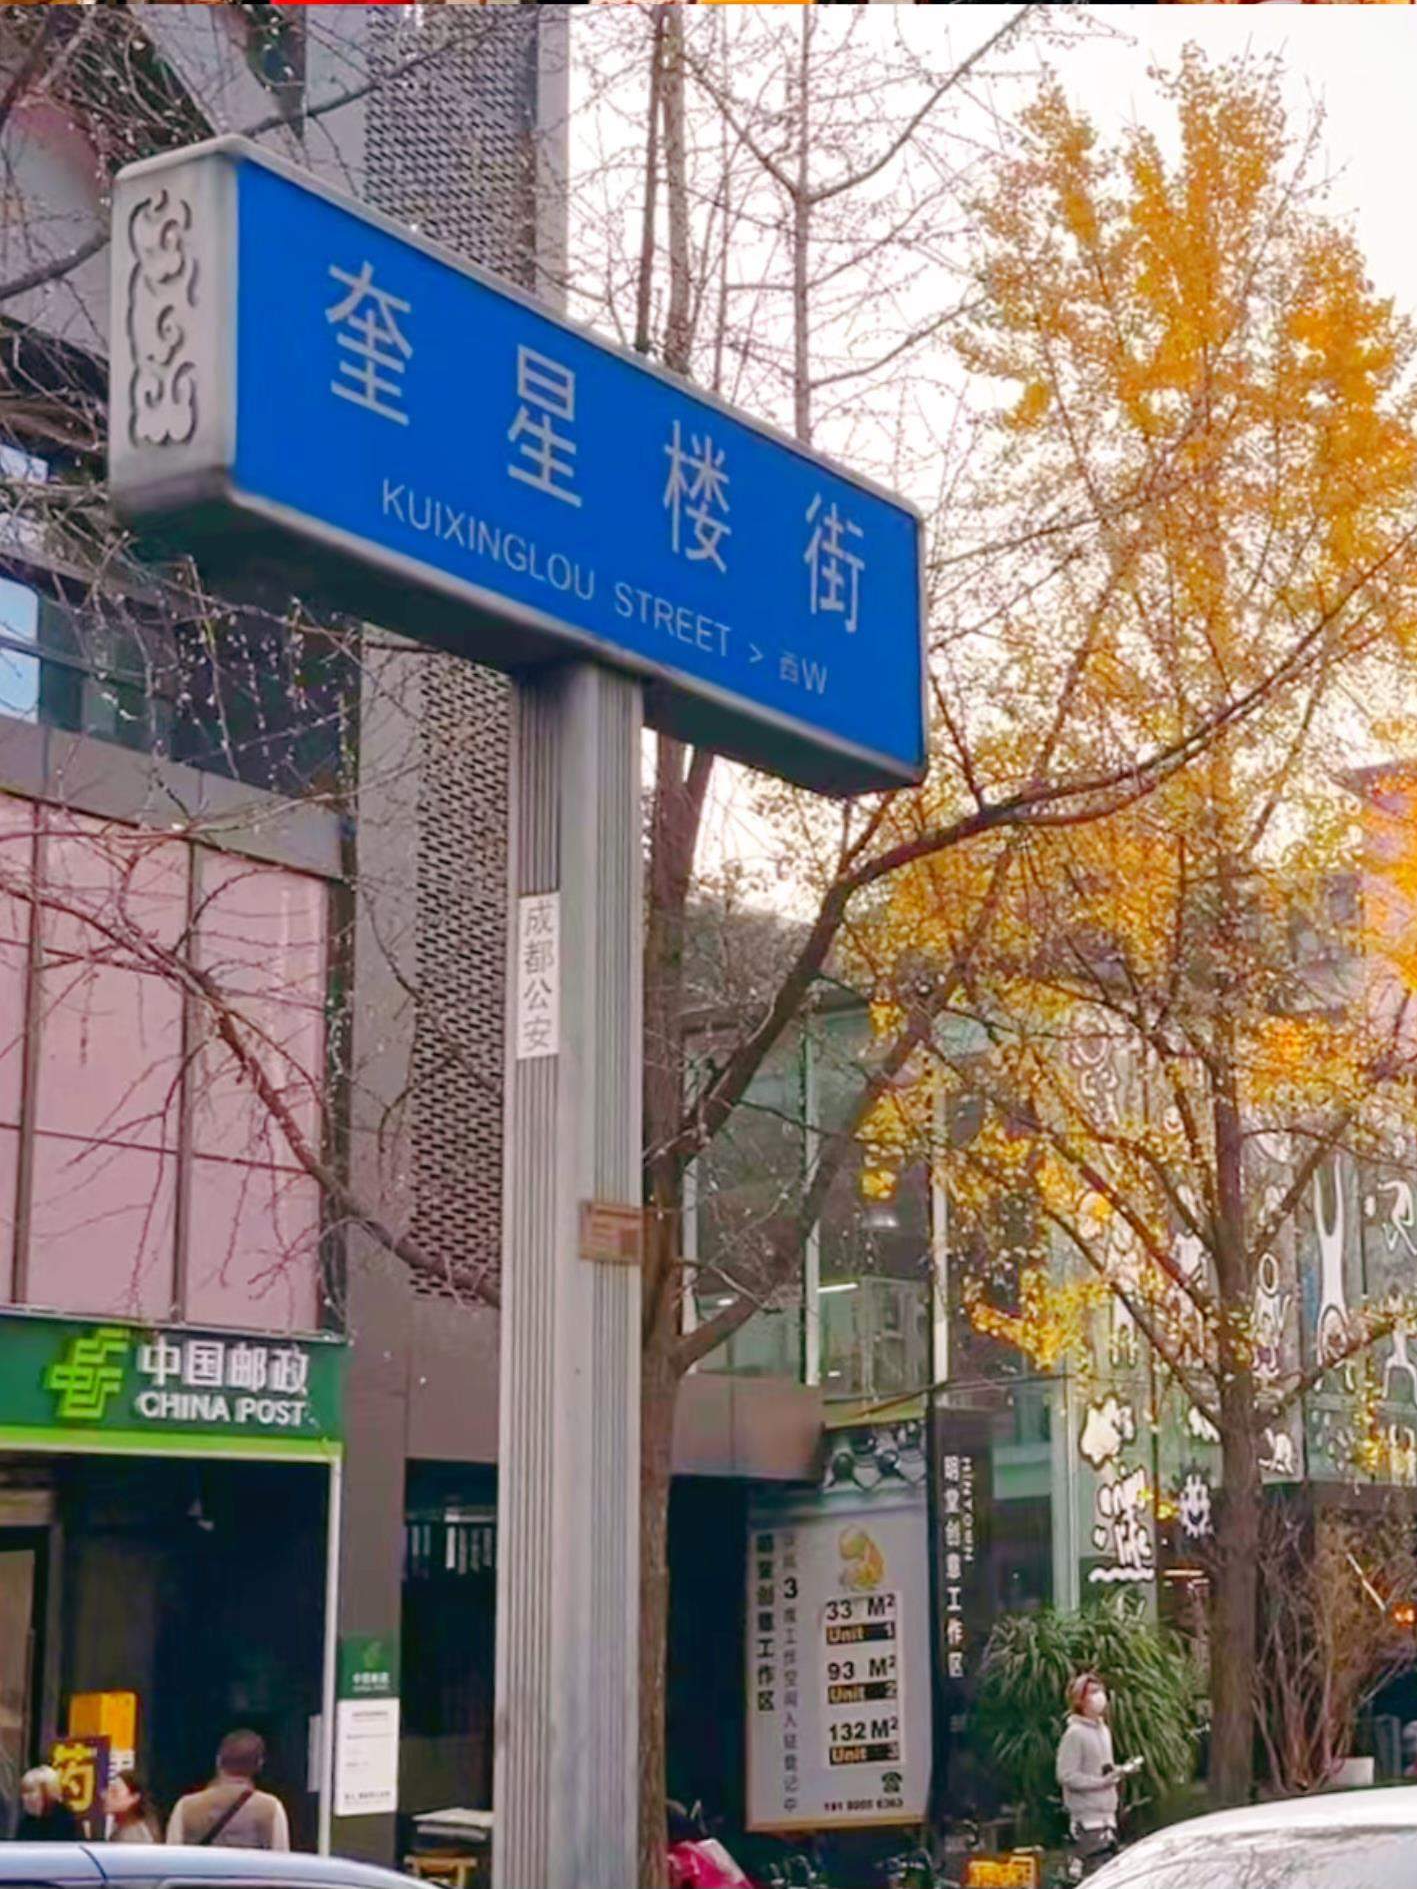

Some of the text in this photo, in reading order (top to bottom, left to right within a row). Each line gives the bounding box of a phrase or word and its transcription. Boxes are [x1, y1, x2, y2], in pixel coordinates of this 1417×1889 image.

[323, 259, 866, 635] 奎星楼街
[382, 477, 596, 602] KUIXINGLOU
[614, 581, 732, 659] STREET
[522, 899, 555, 1052] 成都公安
[138, 1341, 310, 1395] 中国邮政
[137, 1393, 307, 1426] CHINA POST
[826, 1601, 853, 1620] 33
[828, 1628, 864, 1642] Unit
[827, 1662, 854, 1680] 93
[829, 1722, 866, 1742] 132
